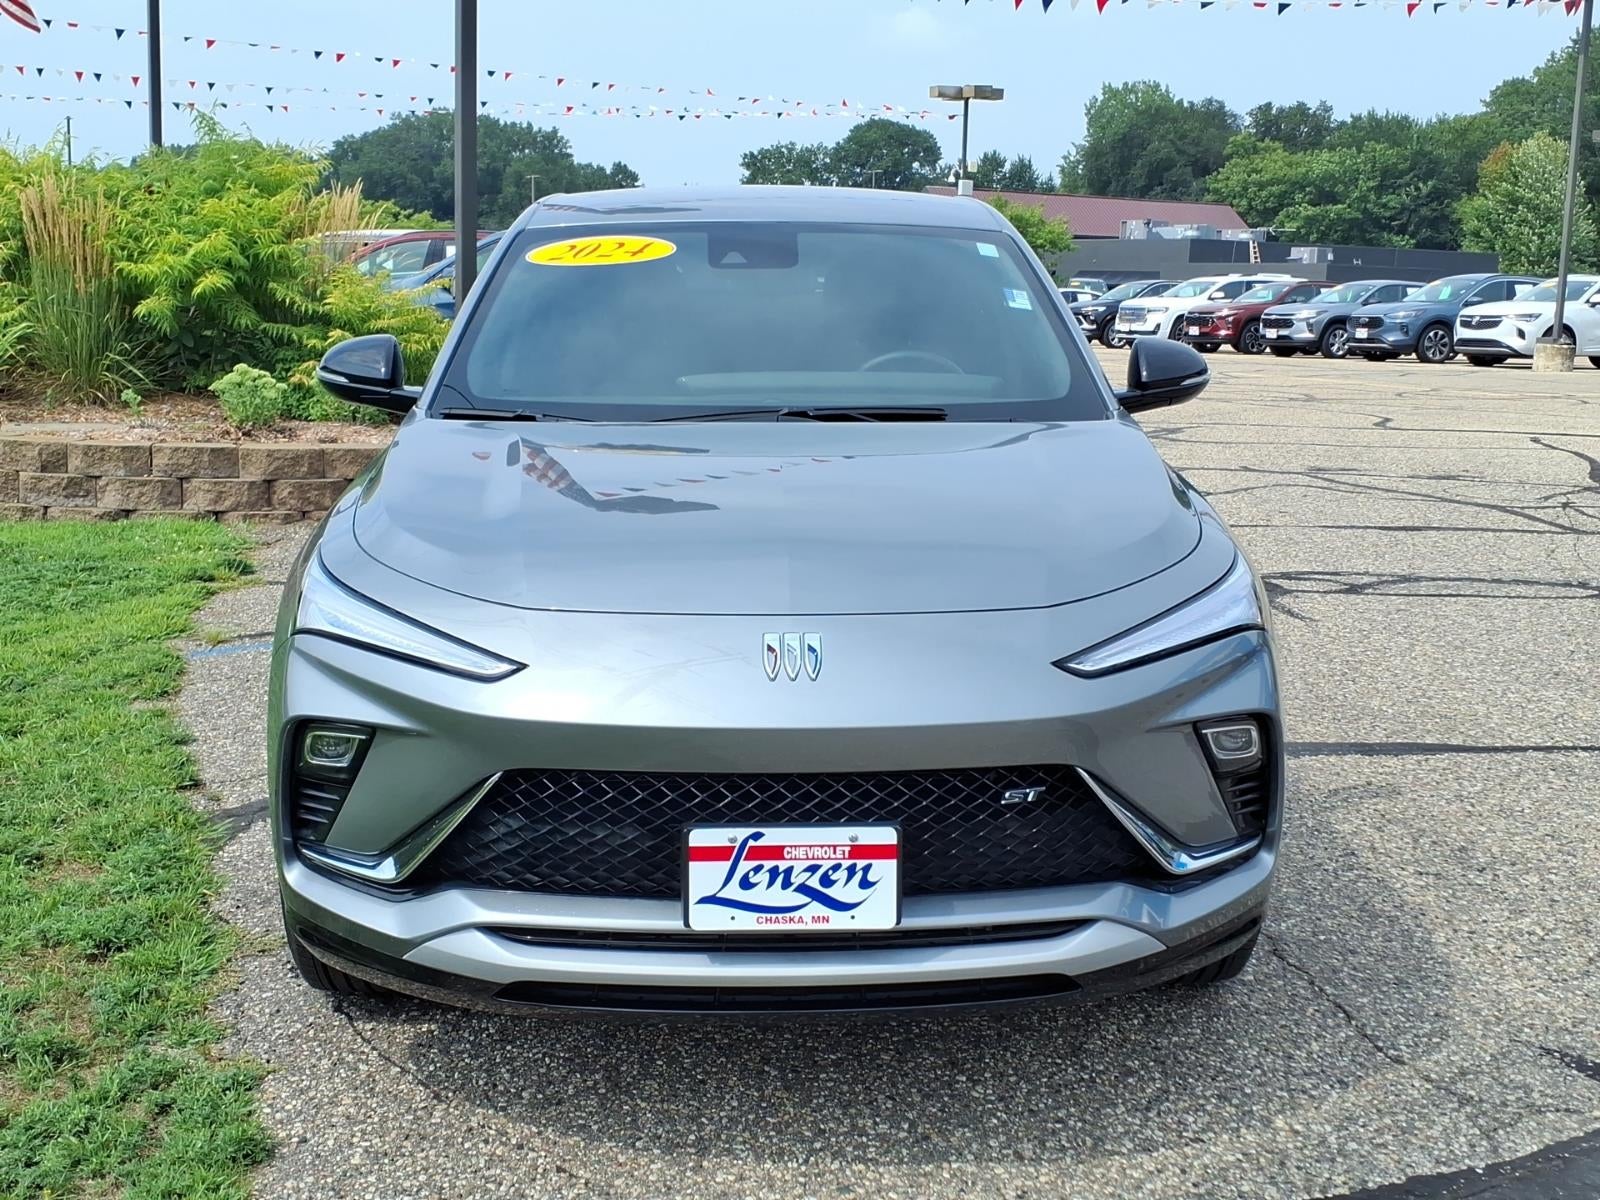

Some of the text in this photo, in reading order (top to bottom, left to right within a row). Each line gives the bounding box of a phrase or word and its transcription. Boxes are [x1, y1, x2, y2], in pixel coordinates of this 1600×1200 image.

[547, 241, 654, 262] 2024
[1001, 786, 1046, 804] ST
[784, 846, 851, 860] CHEVROLET
[693, 831, 883, 914] Lenzen
[756, 915, 830, 926] CHASKA, MN
